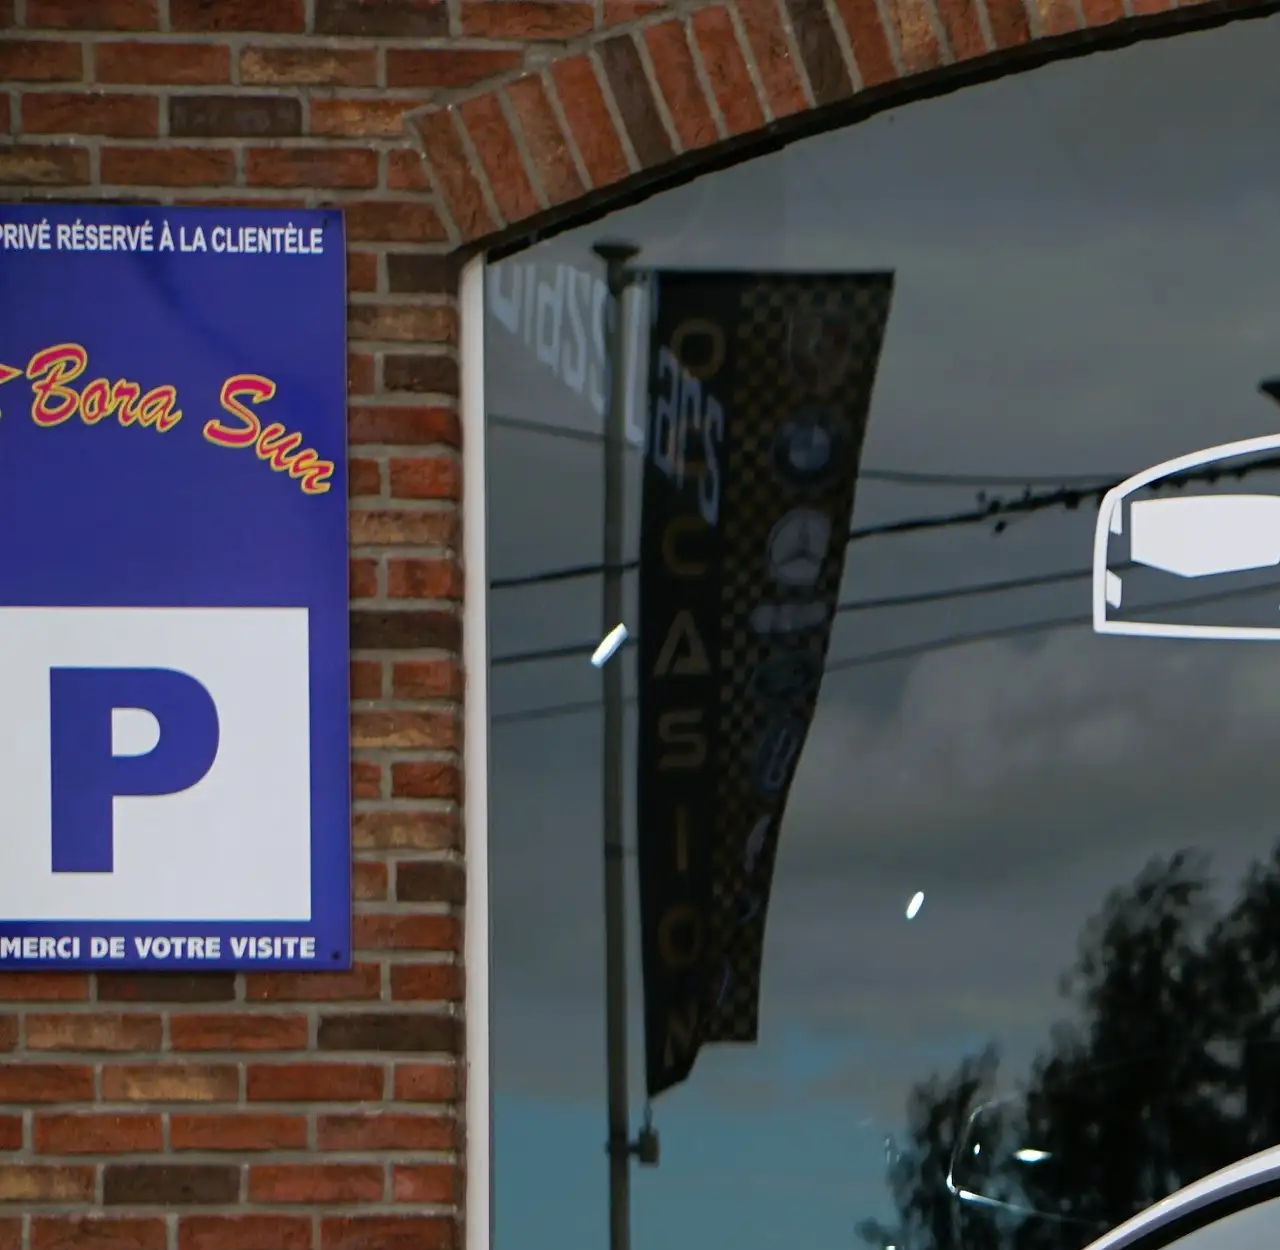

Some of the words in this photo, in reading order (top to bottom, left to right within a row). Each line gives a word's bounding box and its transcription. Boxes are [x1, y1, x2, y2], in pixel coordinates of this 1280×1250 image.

[0, 218, 52, 250] RIVÉ
[57, 219, 154, 251] RÉSERVÉ
[159, 220, 175, 252] À
[180, 226, 207, 252] LA
[211, 222, 324, 254] CLIENTÈLE
[25, 342, 183, 434] Bora
[202, 373, 335, 495] Sun
[48, 664, 220, 873] P
[0, 936, 80, 959] MERCI
[90, 936, 126, 959] DE
[134, 936, 221, 959] VOTRE
[230, 936, 316, 959] VISITE
